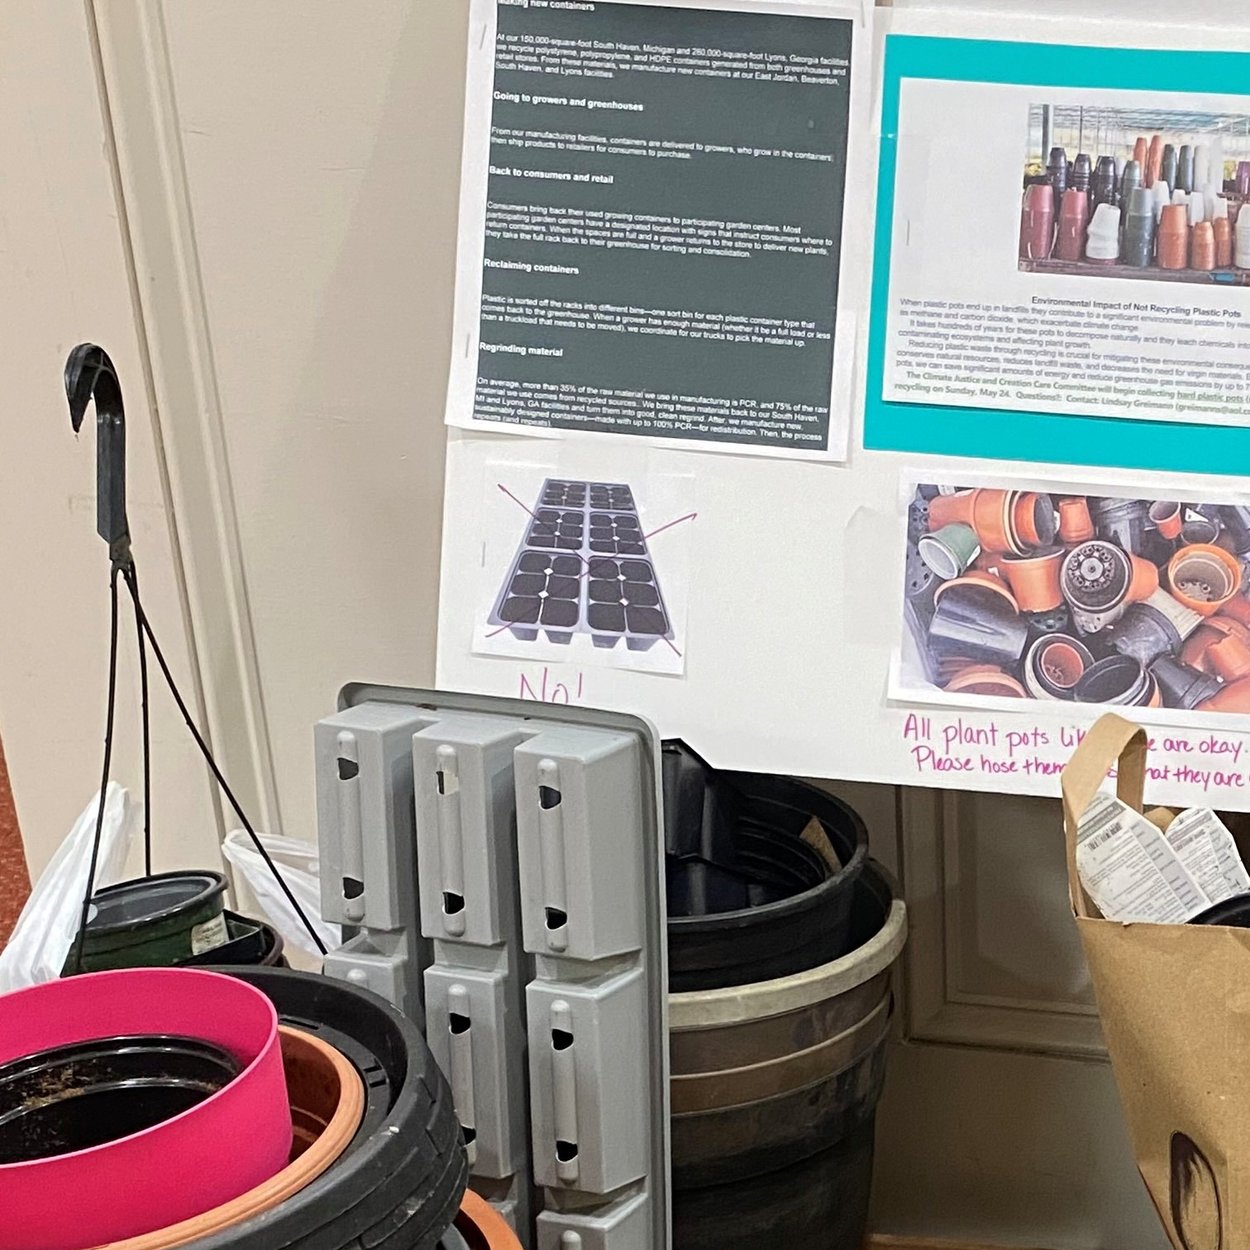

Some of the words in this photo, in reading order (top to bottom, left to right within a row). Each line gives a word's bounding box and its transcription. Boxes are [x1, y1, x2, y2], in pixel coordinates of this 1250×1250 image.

[550, 1, 595, 10] containers
[494, 91, 519, 102] Going
[532, 96, 567, 104] growers
[587, 100, 643, 110] greenhouses
[489, 165, 510, 174] Back
[524, 170, 571, 180] consumers
[591, 175, 614, 183] retail
[484, 259, 531, 272] Reclaiming
[533, 265, 579, 274] containers
[1032, 297, 1090, 308] Environmental
[1093, 300, 1120, 310] Impact
[1133, 303, 1148, 311] Not
[1150, 304, 1190, 315] Recycling
[1192, 307, 1220, 316] Plastic
[1222, 309, 1242, 317] Pots
[480, 342, 526, 355] Regrinding
[528, 348, 563, 356] material
[904, 714, 930, 741] All
[943, 718, 998, 754] plant
[1006, 727, 1049, 757] pots
[1164, 738, 1194, 752] are
[1199, 735, 1248, 763] okay.
[911, 745, 974, 772] Please
[980, 754, 1018, 773] hose
[1174, 765, 1210, 792] they
[1214, 772, 1244, 787] are
